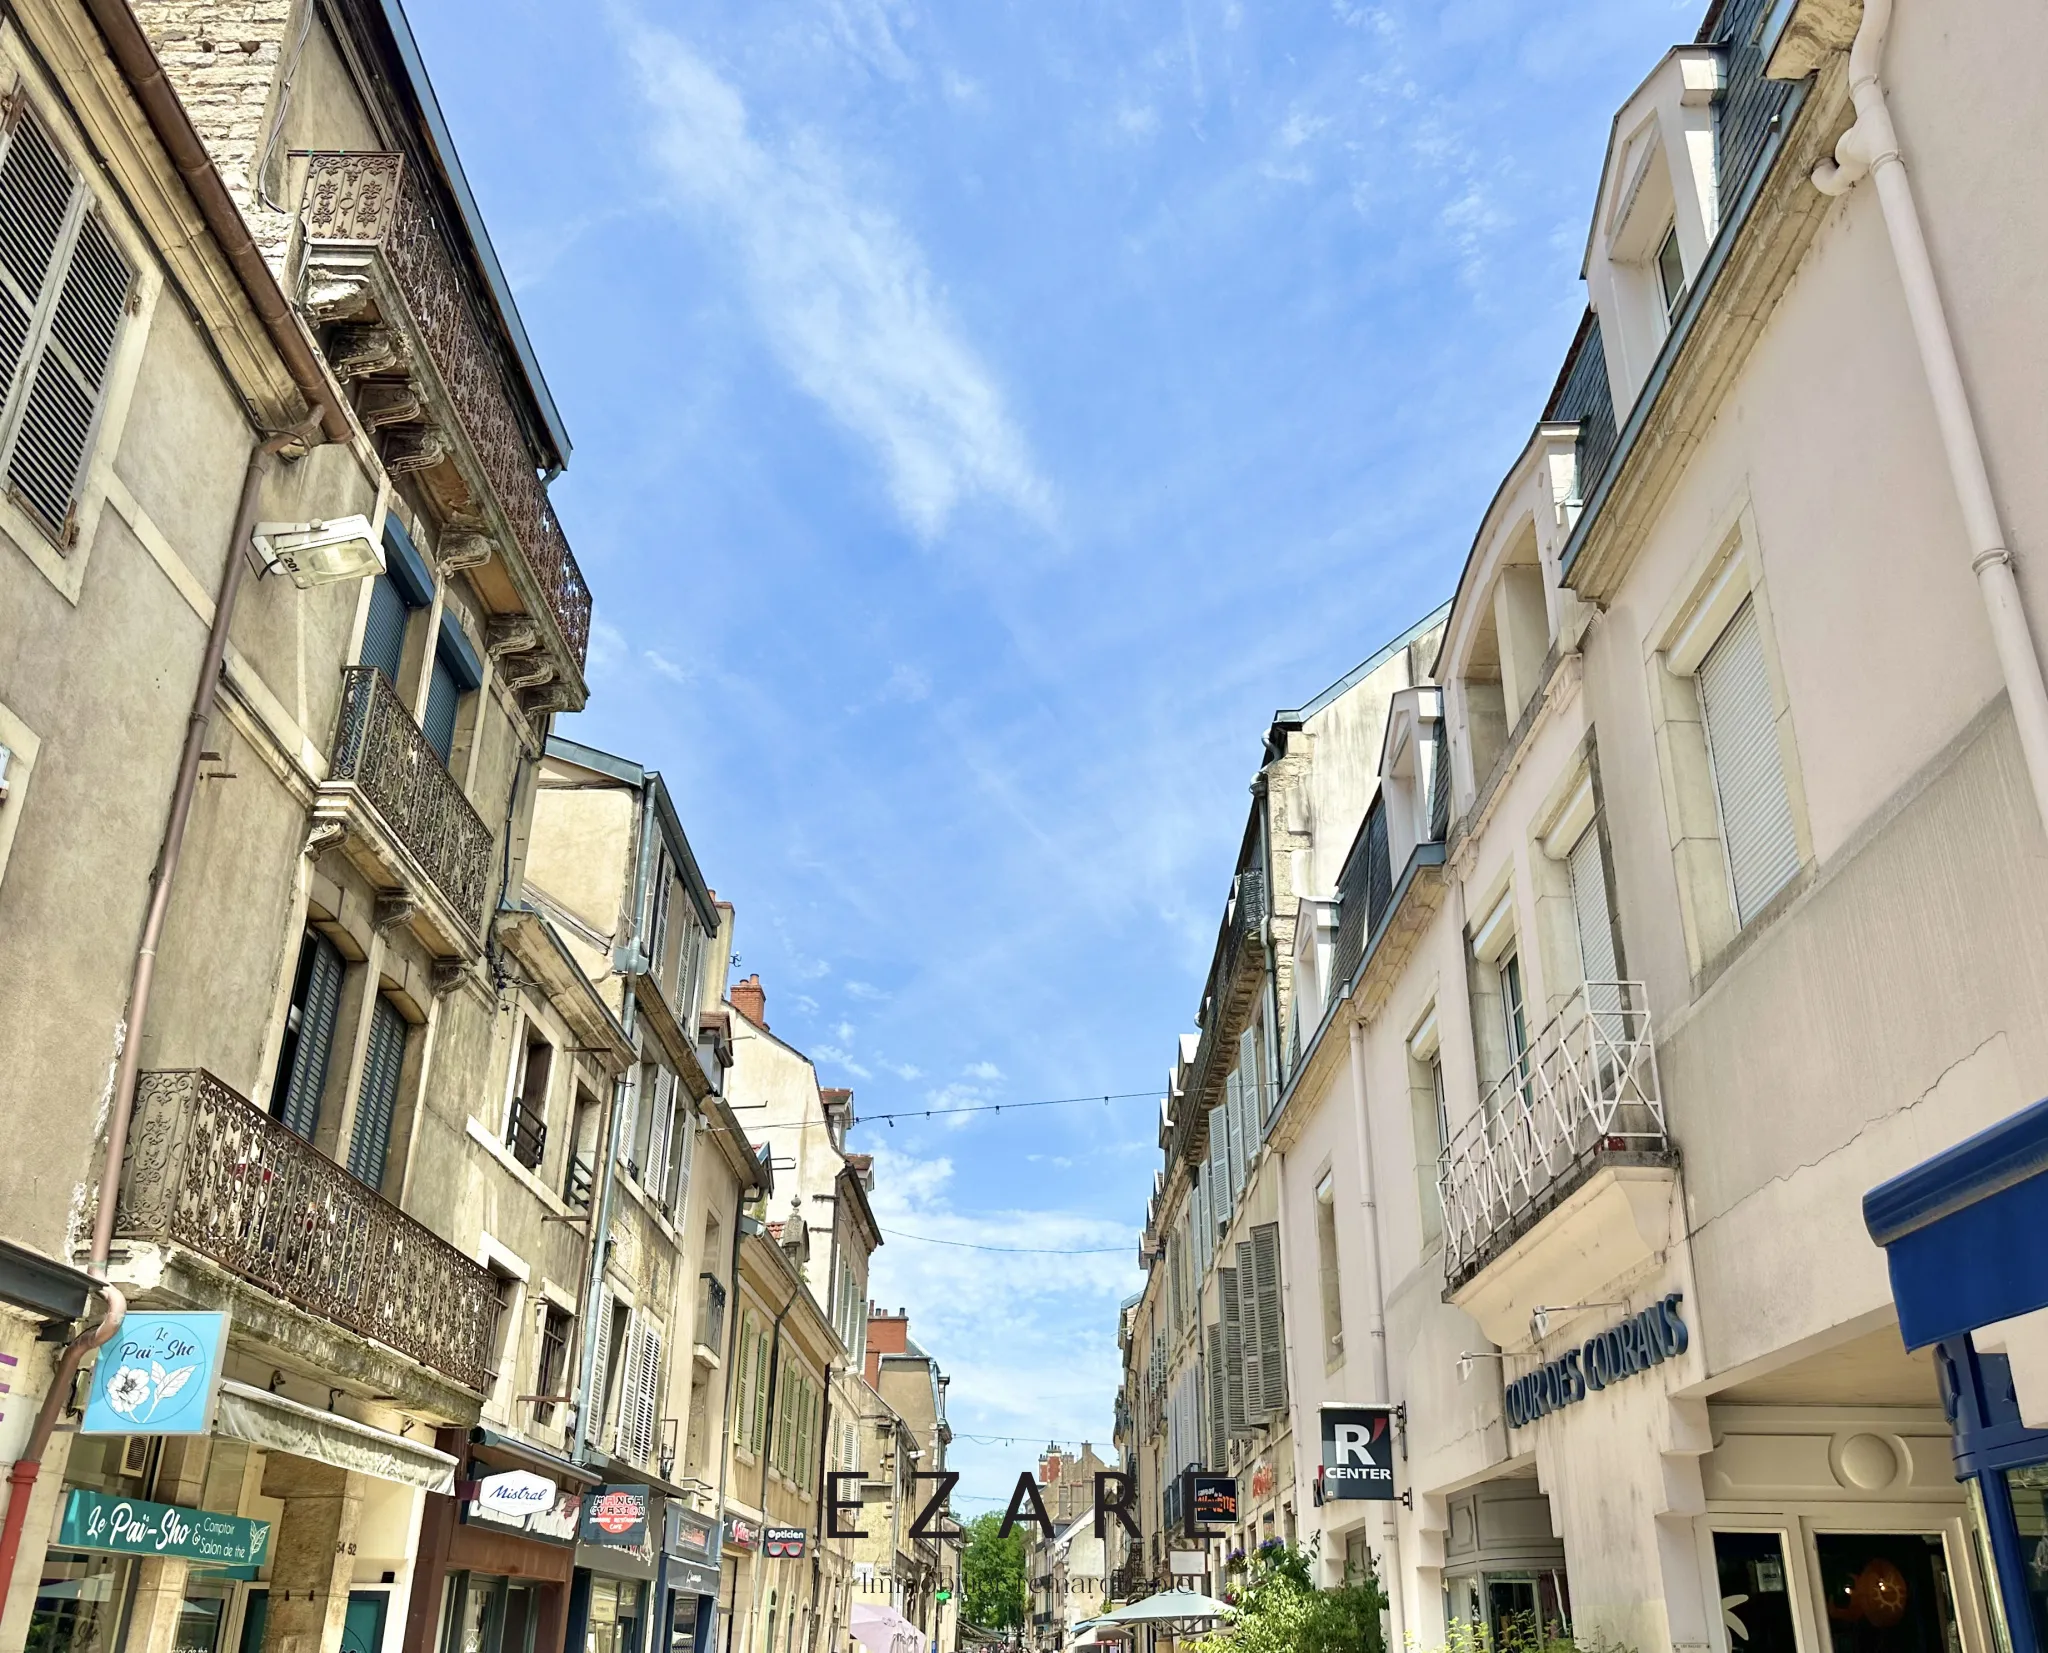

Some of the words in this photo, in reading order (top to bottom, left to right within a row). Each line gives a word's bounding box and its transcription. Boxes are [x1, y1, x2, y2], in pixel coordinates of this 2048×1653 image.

[284, 557, 300, 573] 201
[1505, 1370, 1552, 1429] COUR
[1544, 1349, 1585, 1410] DES
[1583, 1294, 1688, 1391] GODRANS
[1325, 1467, 1392, 1480] CENTER
[489, 1484, 548, 1501] Mistral
[593, 1495, 644, 1506] MANGA
[86, 1505, 107, 1541] Le
[191, 1523, 201, 1546] &
[203, 1517, 236, 1536] Comptoir
[767, 1529, 804, 1540] Opticien
[199, 1537, 222, 1556] Salon
[223, 1546, 233, 1557] de
[347, 1542, 357, 1556] 52
